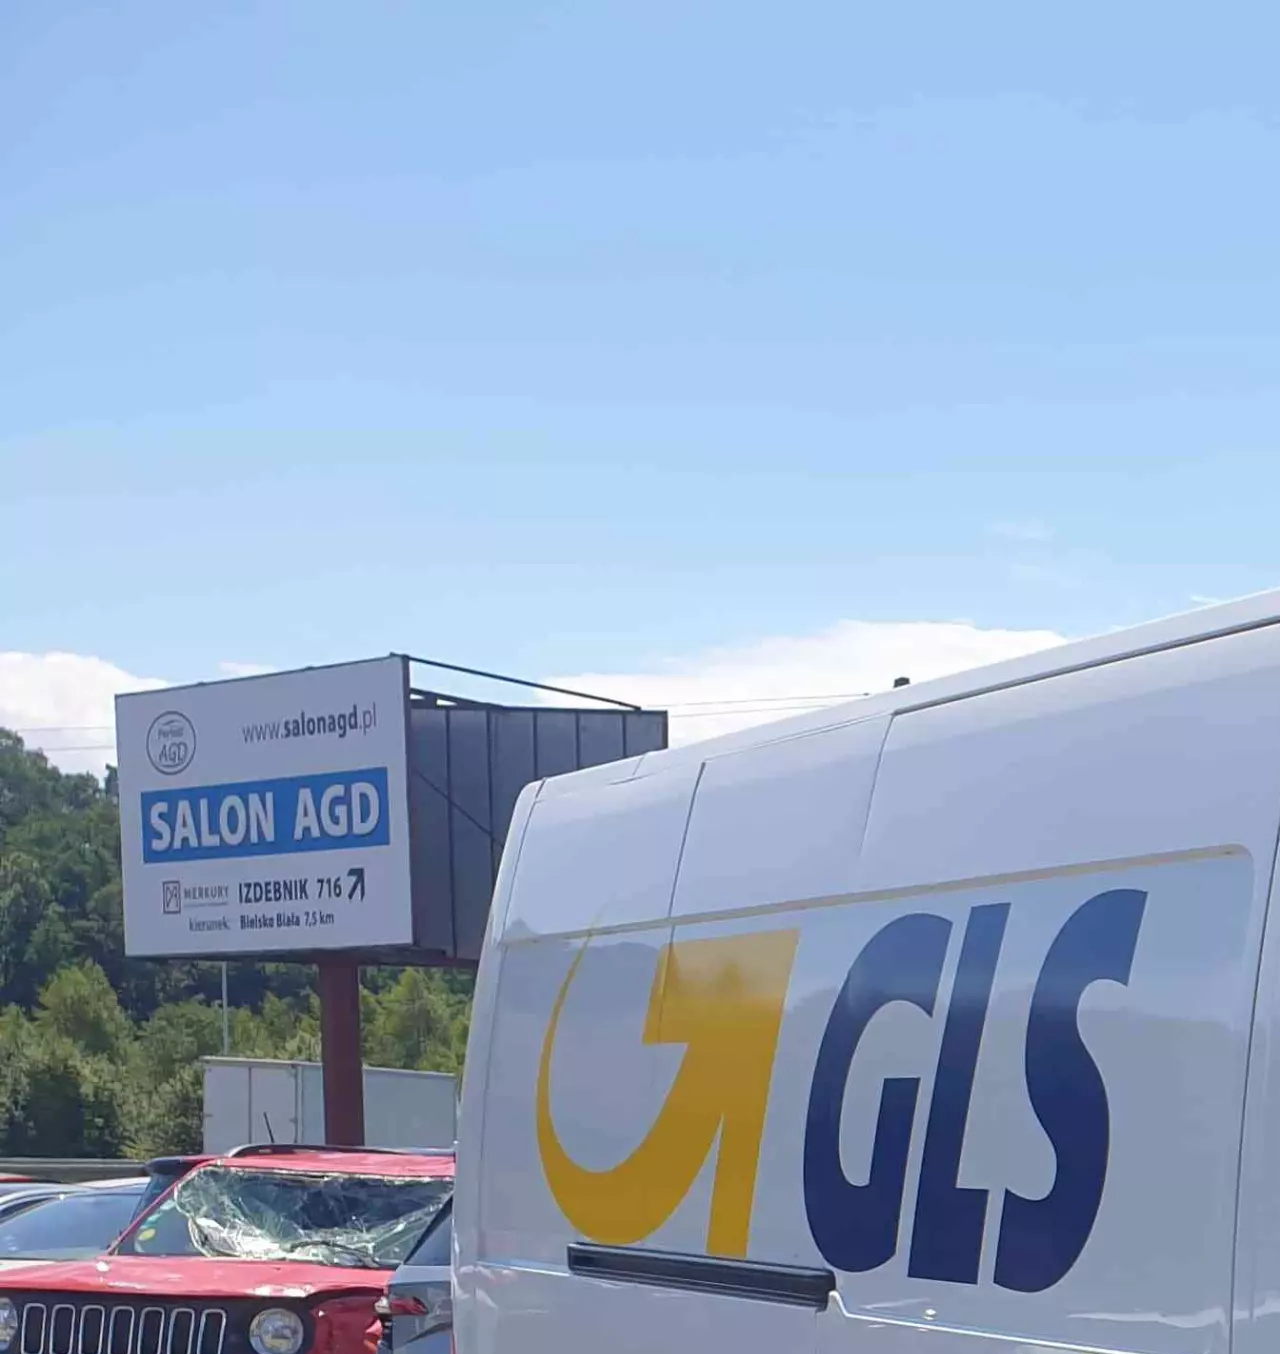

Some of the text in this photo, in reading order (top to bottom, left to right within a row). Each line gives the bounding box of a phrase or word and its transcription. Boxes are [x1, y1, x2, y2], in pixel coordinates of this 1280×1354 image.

[242, 702, 377, 744] www.salonagd.pl
[150, 782, 379, 851] SALON AGD
[238, 876, 342, 904] IZDEBNIK 716
[319, 910, 335, 926] km
[803, 888, 1149, 1293] GLS
